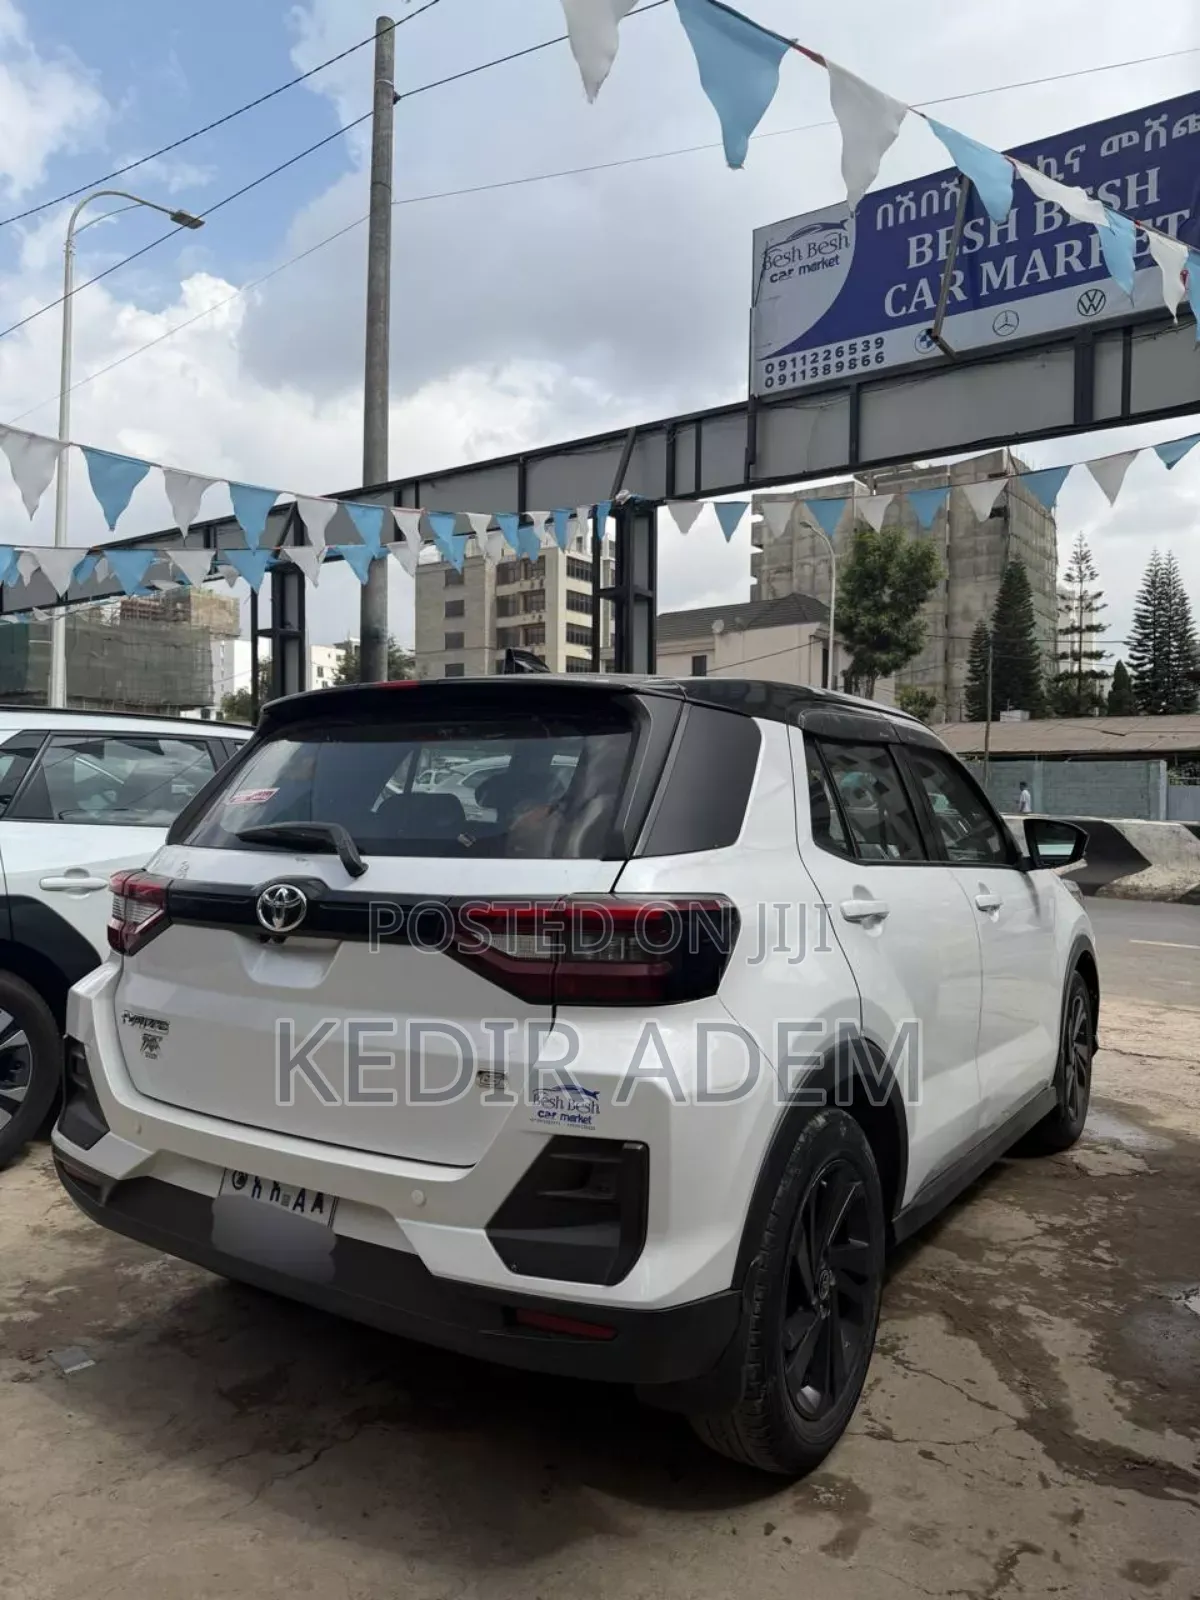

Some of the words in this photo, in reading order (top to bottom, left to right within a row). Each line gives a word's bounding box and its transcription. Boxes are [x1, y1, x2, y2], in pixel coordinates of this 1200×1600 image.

[763, 246, 803, 271] Besh
[808, 232, 850, 259] Besh
[769, 268, 794, 283] car
[799, 254, 840, 276] market
[885, 269, 968, 318] CAR
[764, 351, 885, 389] 0911389866
[765, 336, 885, 374] 0911226539
[538, 1110, 557, 1119] car
[560, 1113, 591, 1124] market
